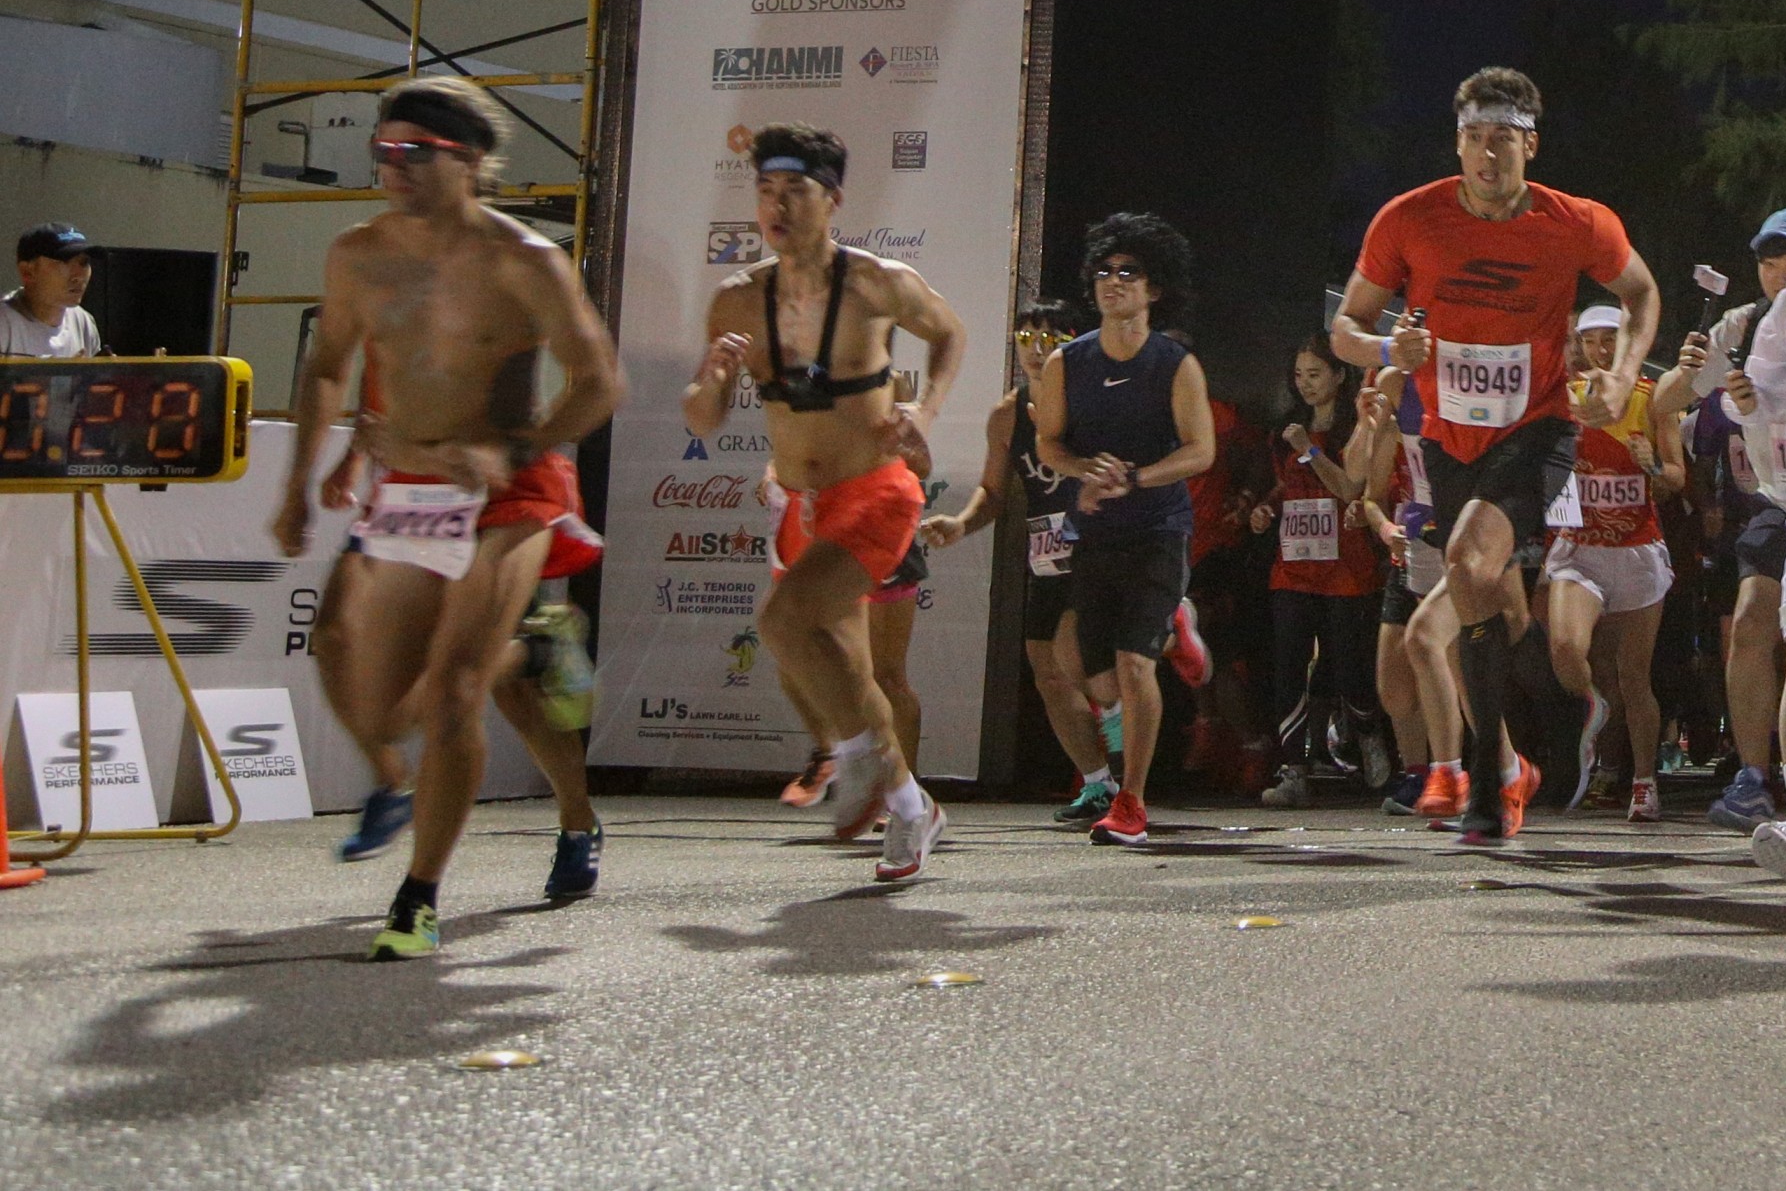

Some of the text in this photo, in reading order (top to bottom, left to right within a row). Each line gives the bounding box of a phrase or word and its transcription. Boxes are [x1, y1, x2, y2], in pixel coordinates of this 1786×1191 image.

[890, 45, 939, 62] FIESTA
[715, 159, 752, 171] HYAT
[714, 171, 756, 182] REGENC
[875, 227, 926, 247] Travel
[1446, 361, 1522, 395] 10949
[67, 463, 197, 477] SEIKO Sports Timer
[1579, 478, 1640, 505] 10455
[1285, 513, 1332, 536] 10500
[678, 582, 756, 593] J.C. TENORIO
[678, 594, 754, 604] ENTERPRISES
[676, 605, 754, 615] INCORPORATED
[641, 697, 761, 722] LJ's LAWN LLC
[638, 731, 784, 743] Cleaning Services Equipment Rentals
[224, 755, 297, 770] KECHERS
[43, 762, 139, 779] SKEHERS
[215, 767, 297, 780] PRFORMANCE
